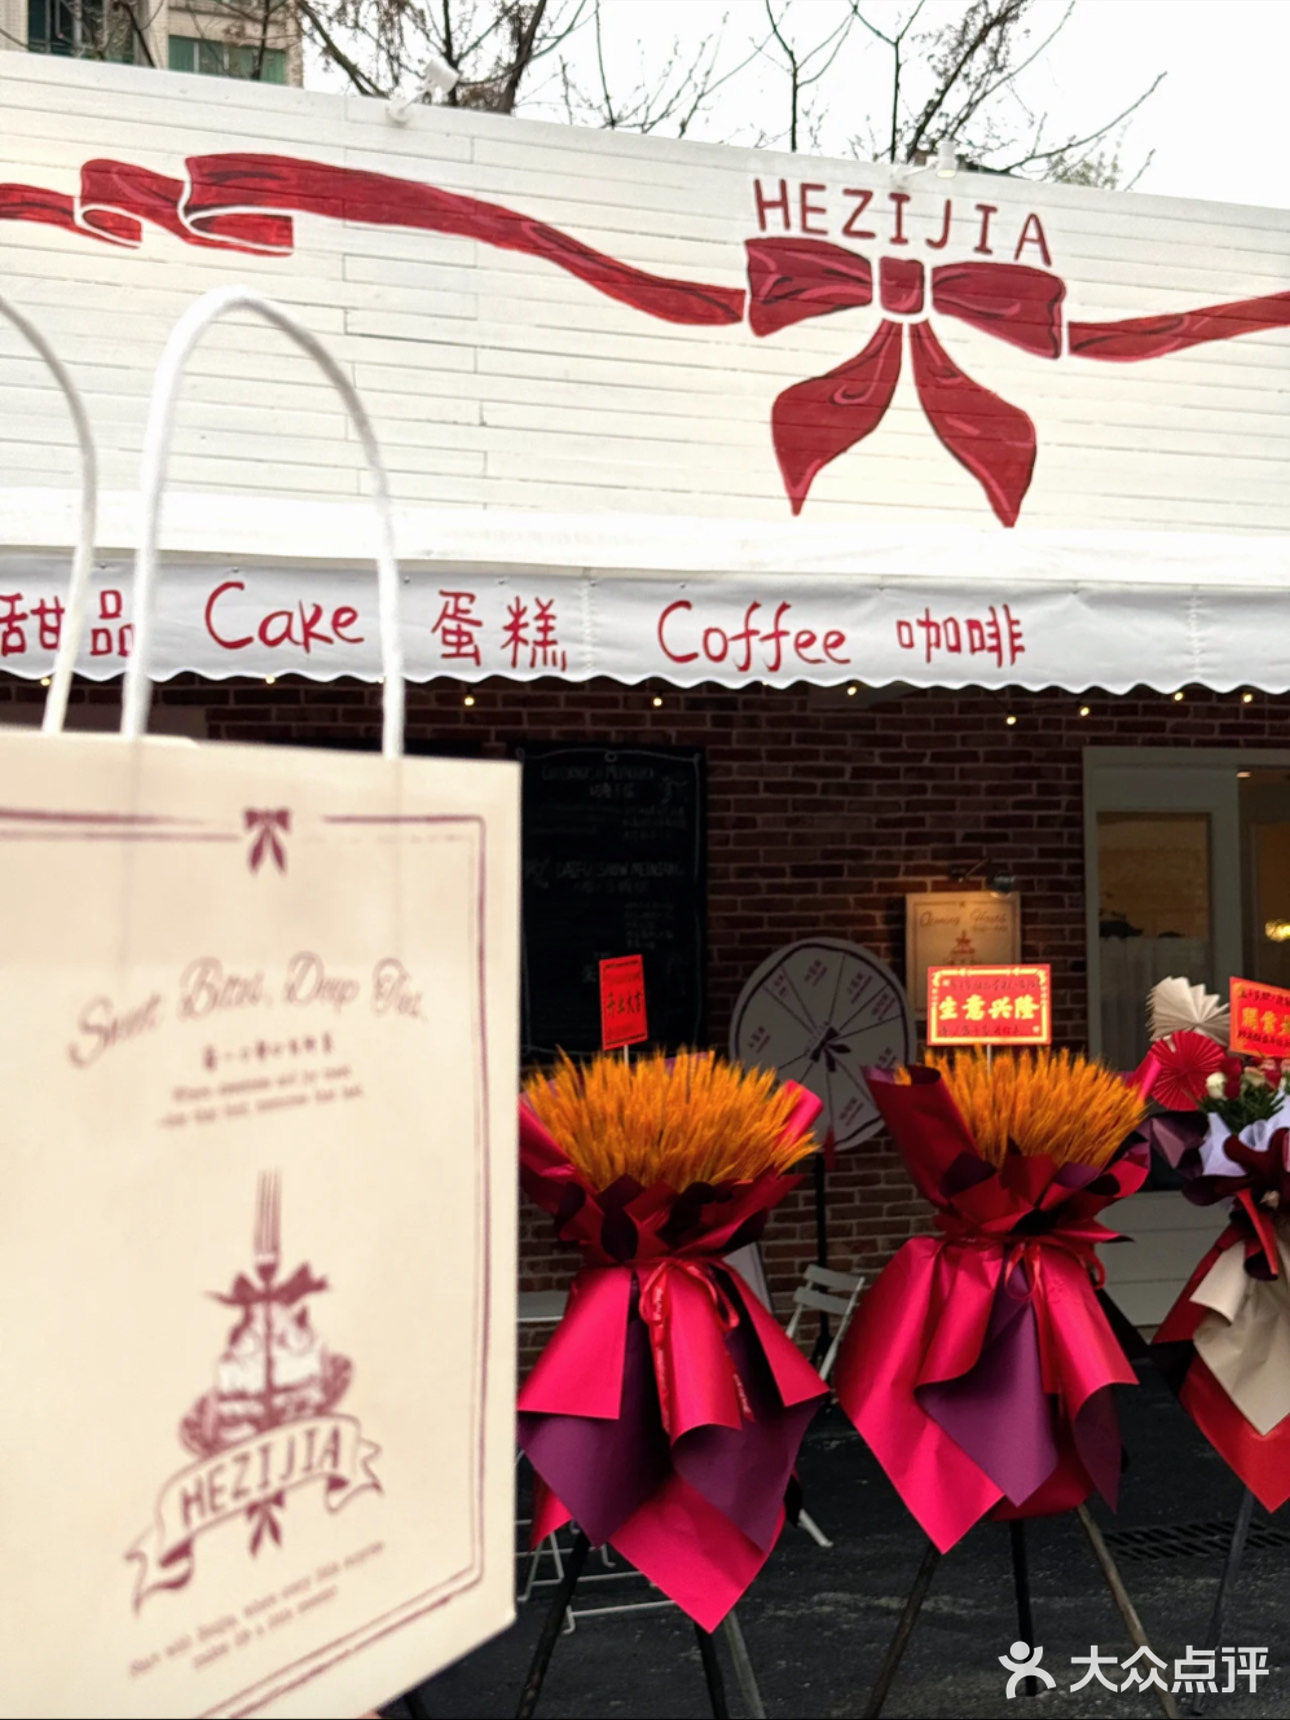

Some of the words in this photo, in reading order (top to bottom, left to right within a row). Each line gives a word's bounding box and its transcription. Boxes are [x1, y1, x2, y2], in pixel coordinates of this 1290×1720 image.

[754, 178, 1053, 267] HEZIJIA
[204, 581, 365, 653] Cake
[431, 589, 567, 671] 蛋糕
[657, 599, 851, 672] Coffee
[897, 602, 1026, 668] 咖啡
[938, 994, 1040, 1022] 生意兴隆
[180, 1425, 343, 1529] HEZIJIA
